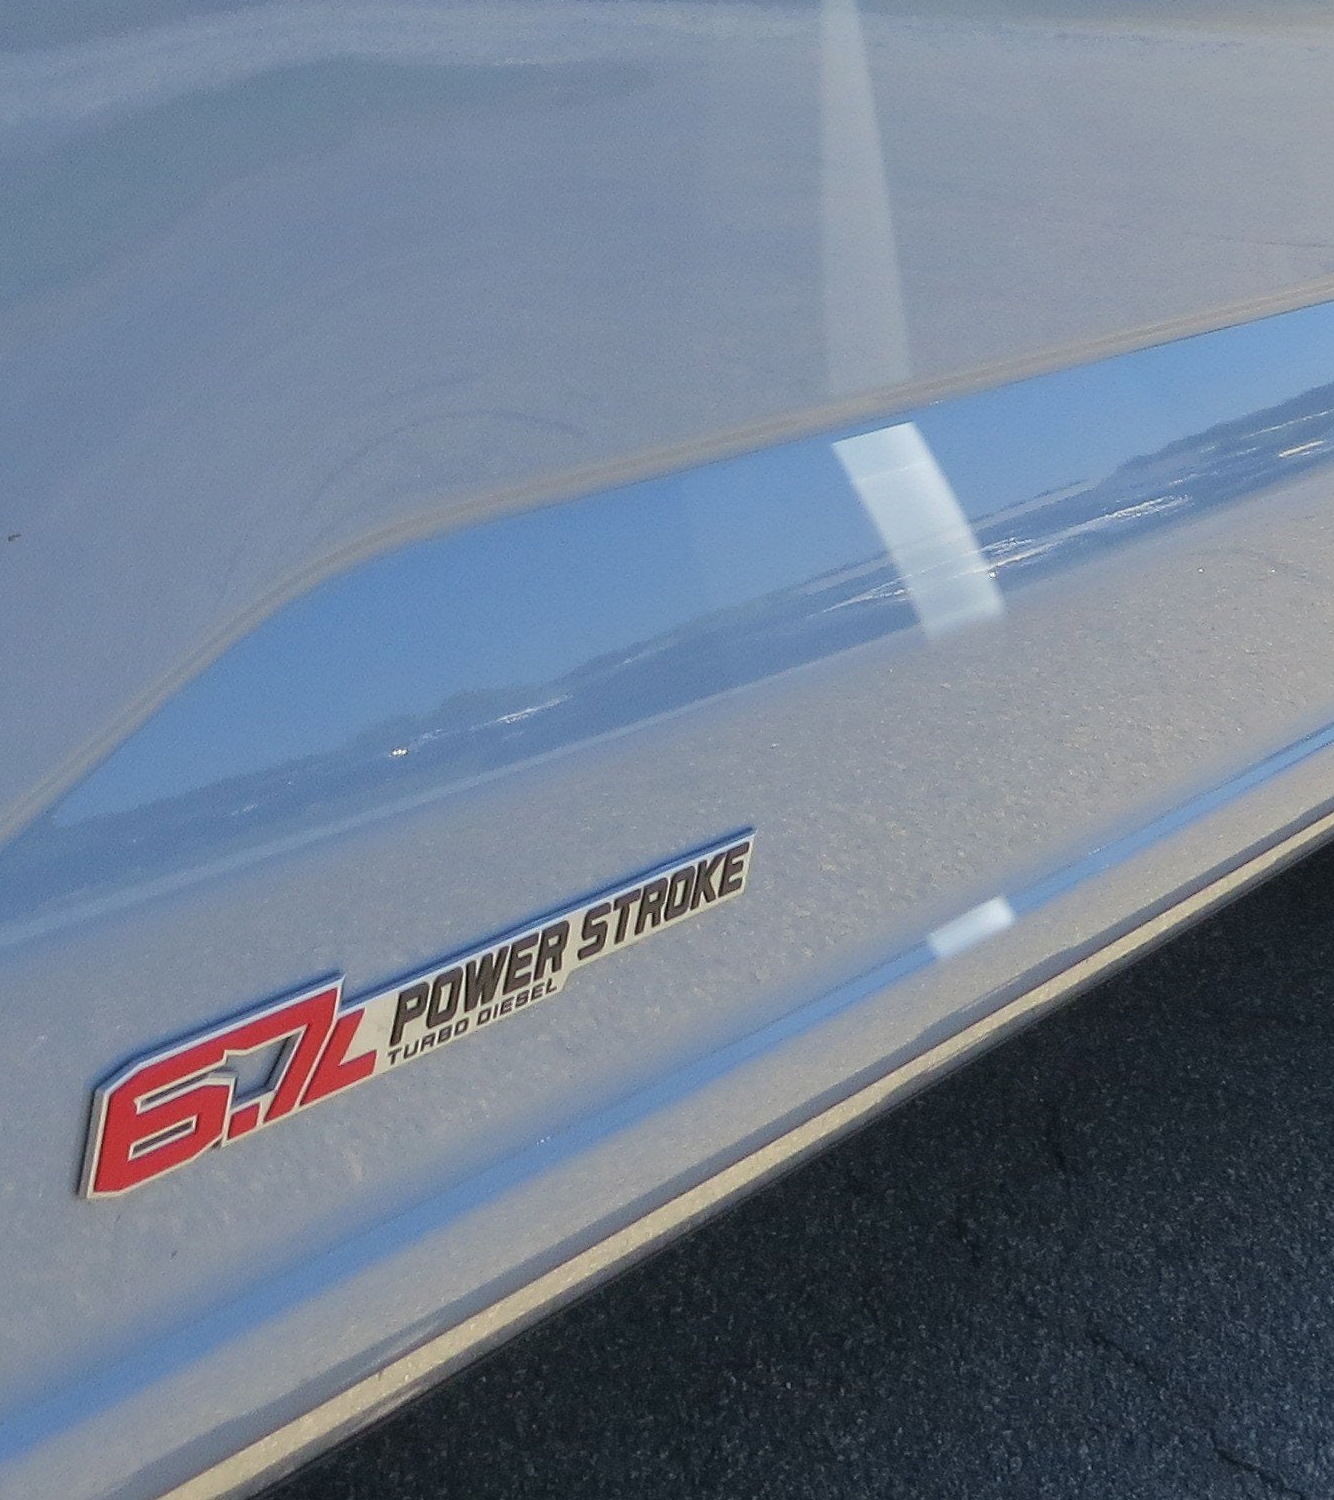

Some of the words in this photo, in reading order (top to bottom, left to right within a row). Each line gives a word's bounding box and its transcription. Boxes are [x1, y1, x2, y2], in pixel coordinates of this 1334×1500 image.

[387, 1016, 471, 1066] TURBO
[476, 977, 559, 1027] DIESEL
[389, 920, 570, 1047] POWER
[577, 841, 751, 962] STROKE
[92, 987, 377, 1194] 6.7L
